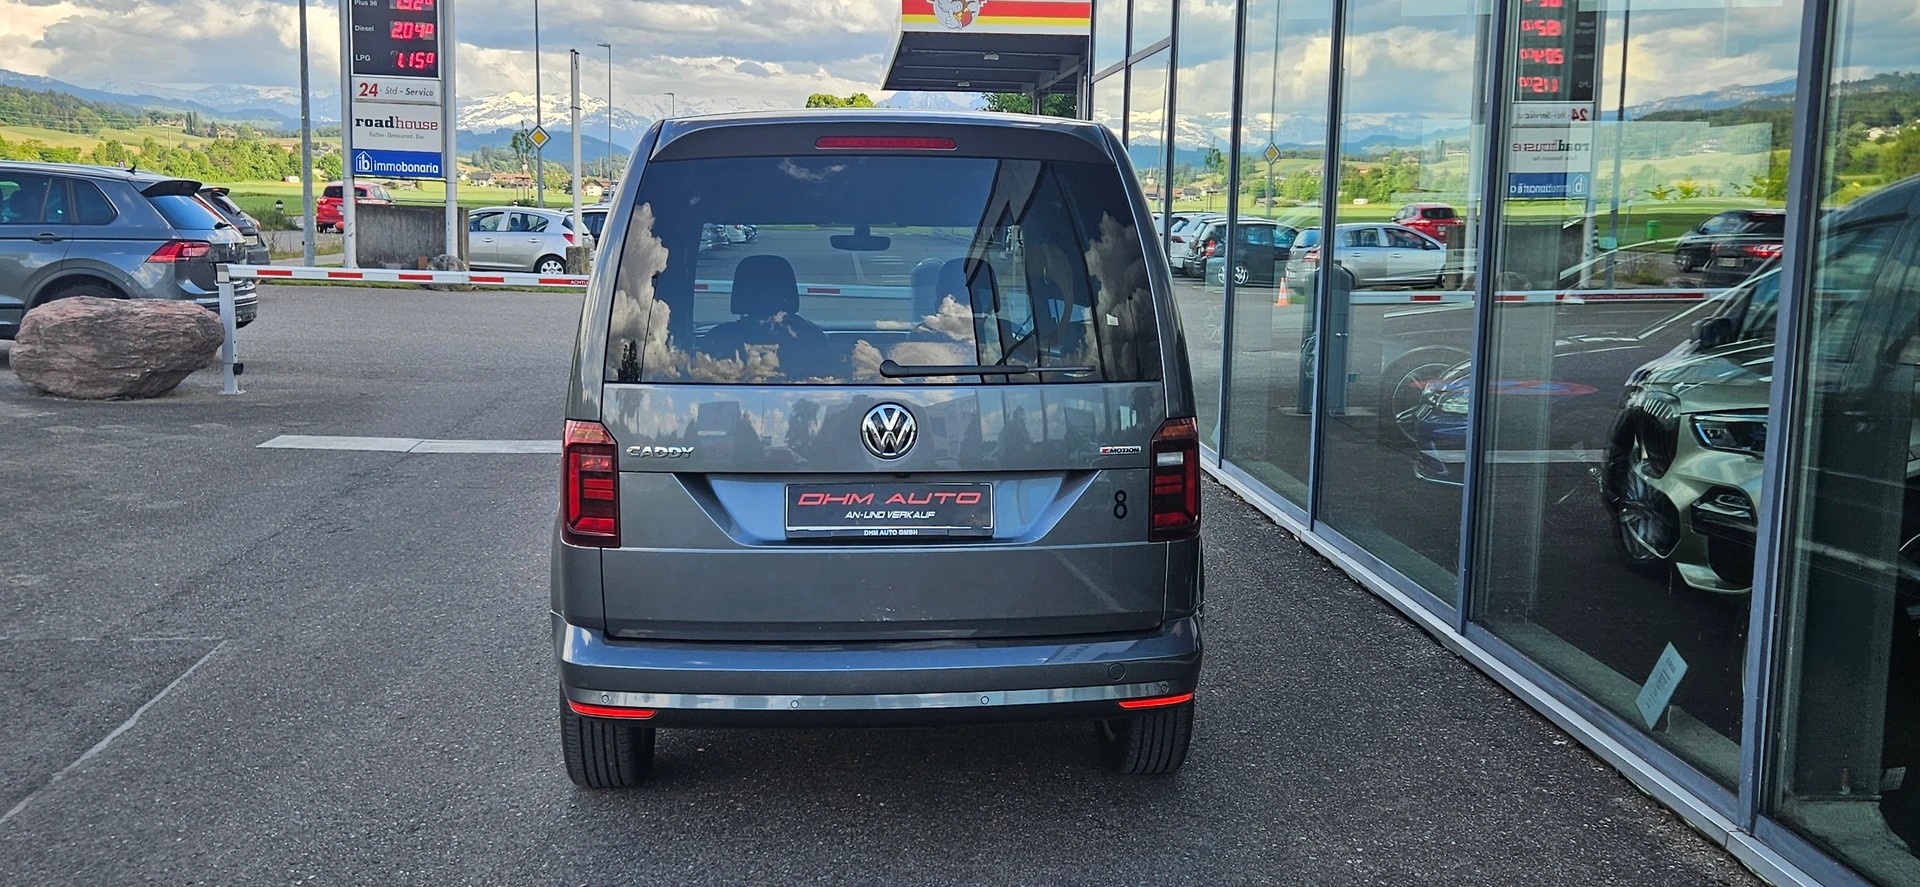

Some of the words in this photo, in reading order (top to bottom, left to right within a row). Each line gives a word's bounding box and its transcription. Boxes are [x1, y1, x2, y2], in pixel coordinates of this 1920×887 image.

[355, 54, 371, 62] LPG
[359, 82, 379, 97] 24
[385, 86, 398, 95] Std
[405, 87, 434, 97] Service
[355, 115, 438, 131] roadhouse
[374, 160, 439, 174] immobonaria
[862, 403, 916, 458] VW
[626, 445, 695, 459] CADDY
[798, 492, 875, 506] DHM
[885, 491, 982, 506] AUTO
[1113, 489, 1128, 520] 8
[886, 510, 936, 519] VERKAUF
